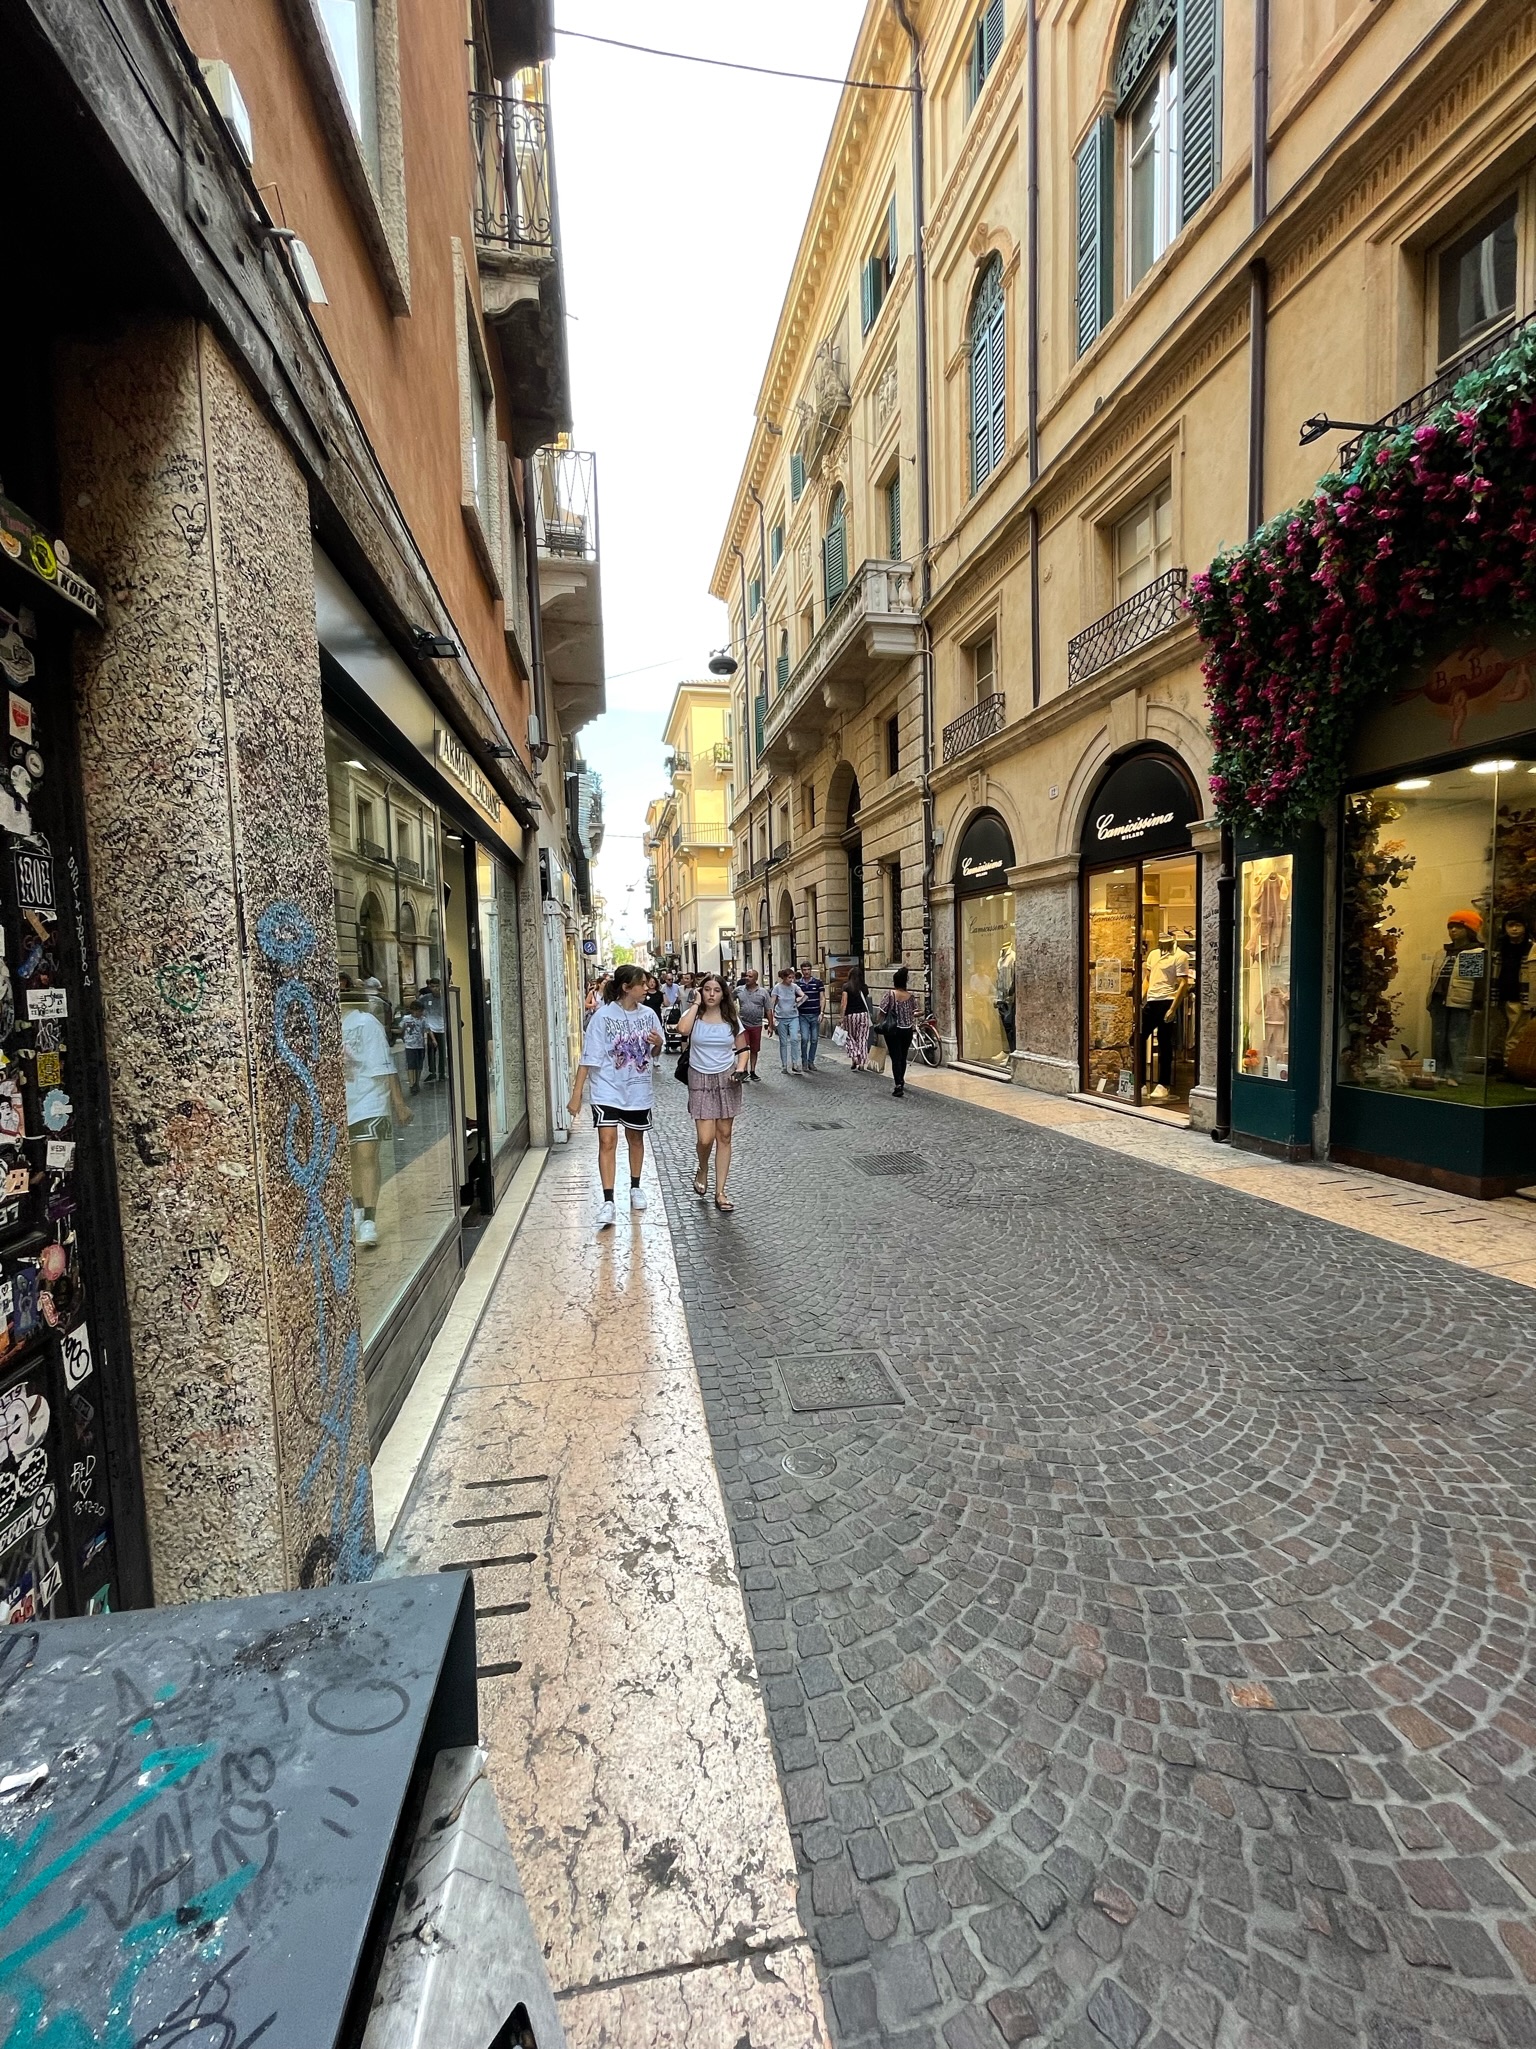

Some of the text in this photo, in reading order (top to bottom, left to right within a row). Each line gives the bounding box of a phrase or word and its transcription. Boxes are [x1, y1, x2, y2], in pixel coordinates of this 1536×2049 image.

[60, 573, 96, 610] KOKO
[439, 729, 501, 823] ARMANI EXCHANGE
[1096, 812, 1174, 840] Camicissima
[1121, 830, 1144, 841] MILANO
